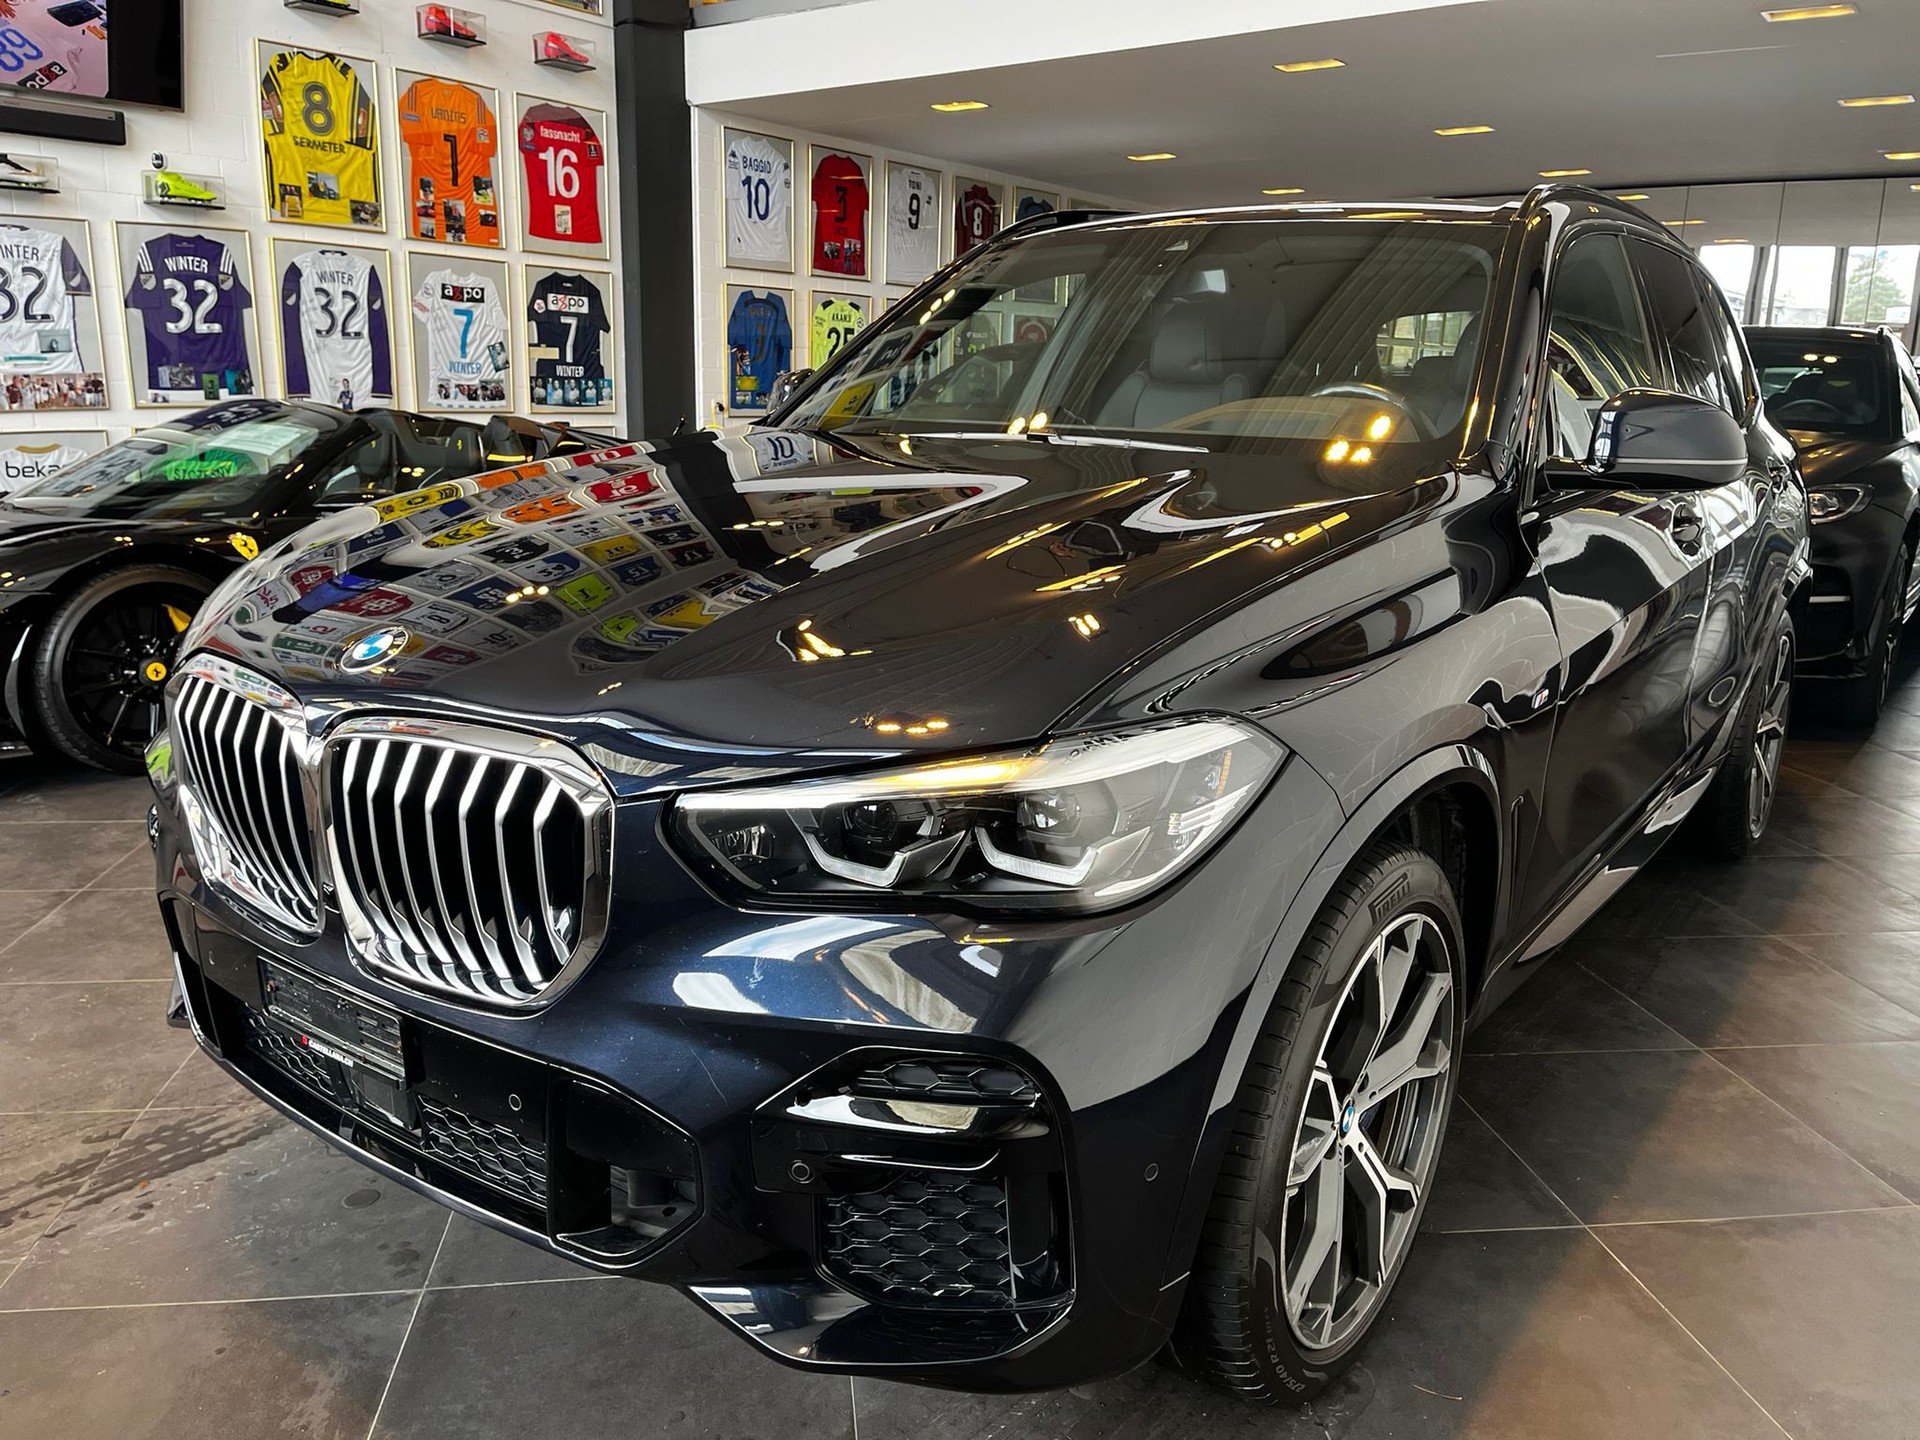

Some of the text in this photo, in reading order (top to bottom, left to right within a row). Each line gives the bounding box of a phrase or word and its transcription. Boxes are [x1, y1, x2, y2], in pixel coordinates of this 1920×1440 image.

[303, 82, 335, 136] 8
[293, 136, 346, 155] SERMETER
[443, 133, 459, 187] 1
[742, 155, 772, 174] BAGGIO
[538, 146, 580, 198] 16
[741, 175, 770, 221] 10
[835, 185, 848, 223] 3
[908, 193, 921, 230] 9
[973, 207, 983, 236] 8
[0, 244, 39, 261] INTER
[164, 256, 209, 273] WINTER
[316, 270, 354, 287] WINTER
[163, 278, 222, 334] 32
[314, 286, 364, 340] 32
[453, 308, 474, 359] 7
[560, 316, 578, 363] 7
[449, 360, 482, 375] WINTER
[556, 364, 584, 378] WINTER
[1367, 872, 1410, 926] PIRELLI
